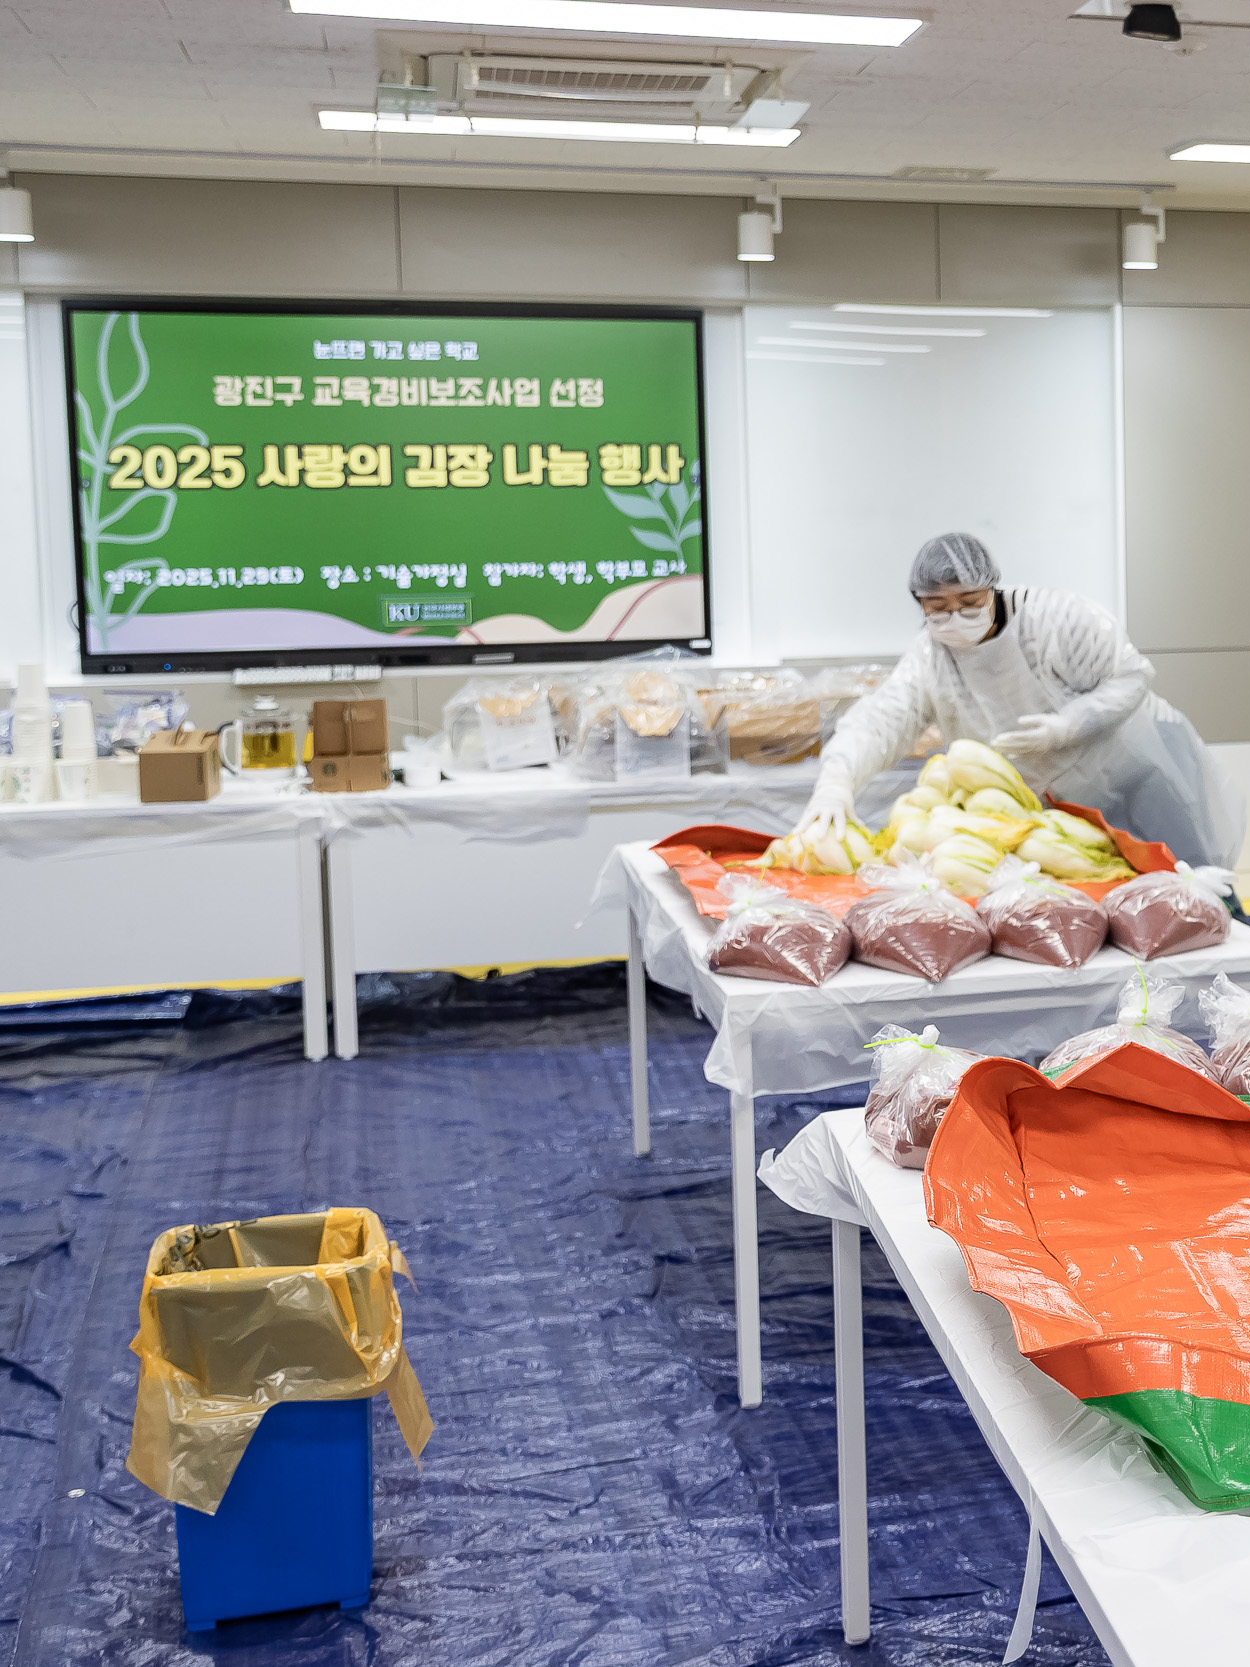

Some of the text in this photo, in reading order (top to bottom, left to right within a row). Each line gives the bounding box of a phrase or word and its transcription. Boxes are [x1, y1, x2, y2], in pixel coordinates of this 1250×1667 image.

[369, 341, 404, 360] 가고
[408, 341, 441, 361] 싶은
[445, 341, 479, 361] 학교
[213, 376, 604, 408] 광진구 교육경비보조사업 선정
[108, 443, 685, 489] 2025 사랑의 김장 나눔 행사
[321, 565, 359, 589] 장소
[376, 563, 467, 589] 기술가정실
[596, 560, 648, 584] 학부모
[652, 559, 687, 577] 교사
[389, 603, 419, 621] KU
